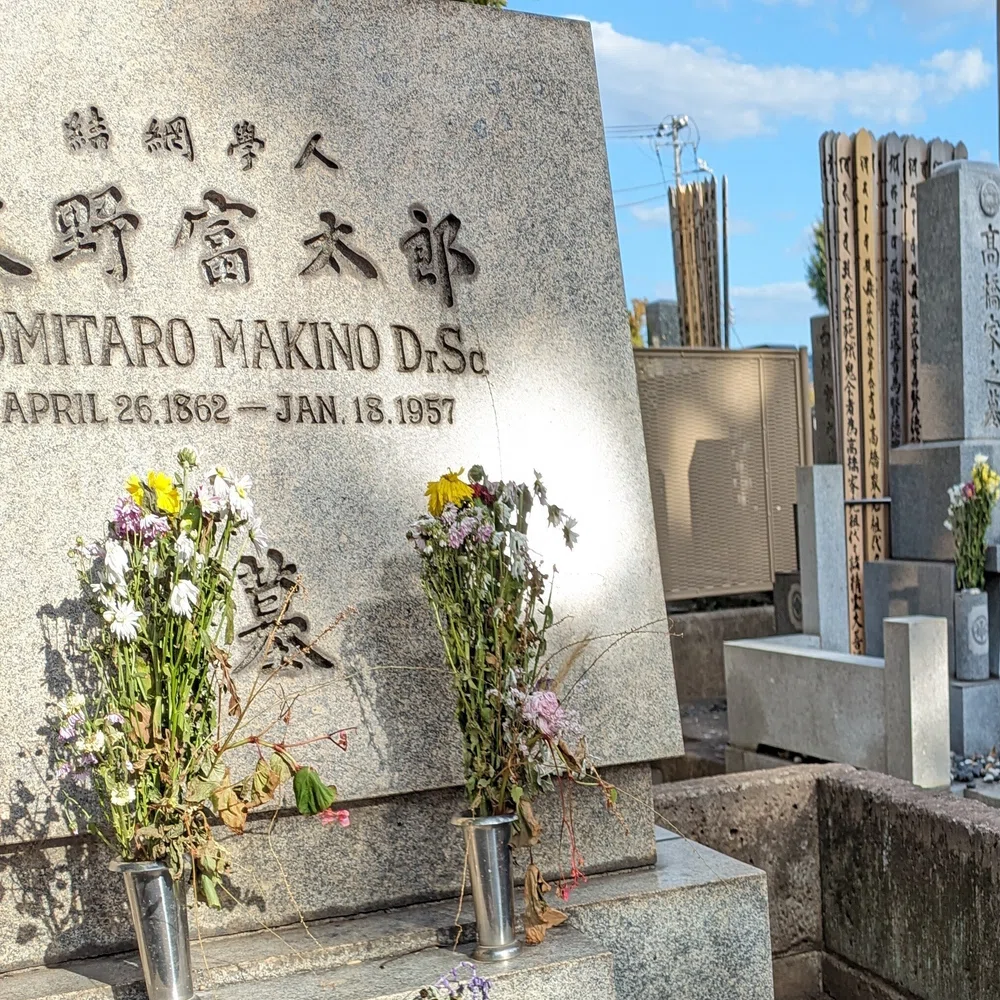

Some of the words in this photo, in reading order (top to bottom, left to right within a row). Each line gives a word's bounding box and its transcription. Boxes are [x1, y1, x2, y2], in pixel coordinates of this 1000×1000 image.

[0, 186, 476, 307] 野富太郎
[0, 312, 196, 368] MITARO
[208, 317, 381, 371] MAKINO
[2, 391, 108, 425] APRIL
[235, 546, 336, 674] 墓
